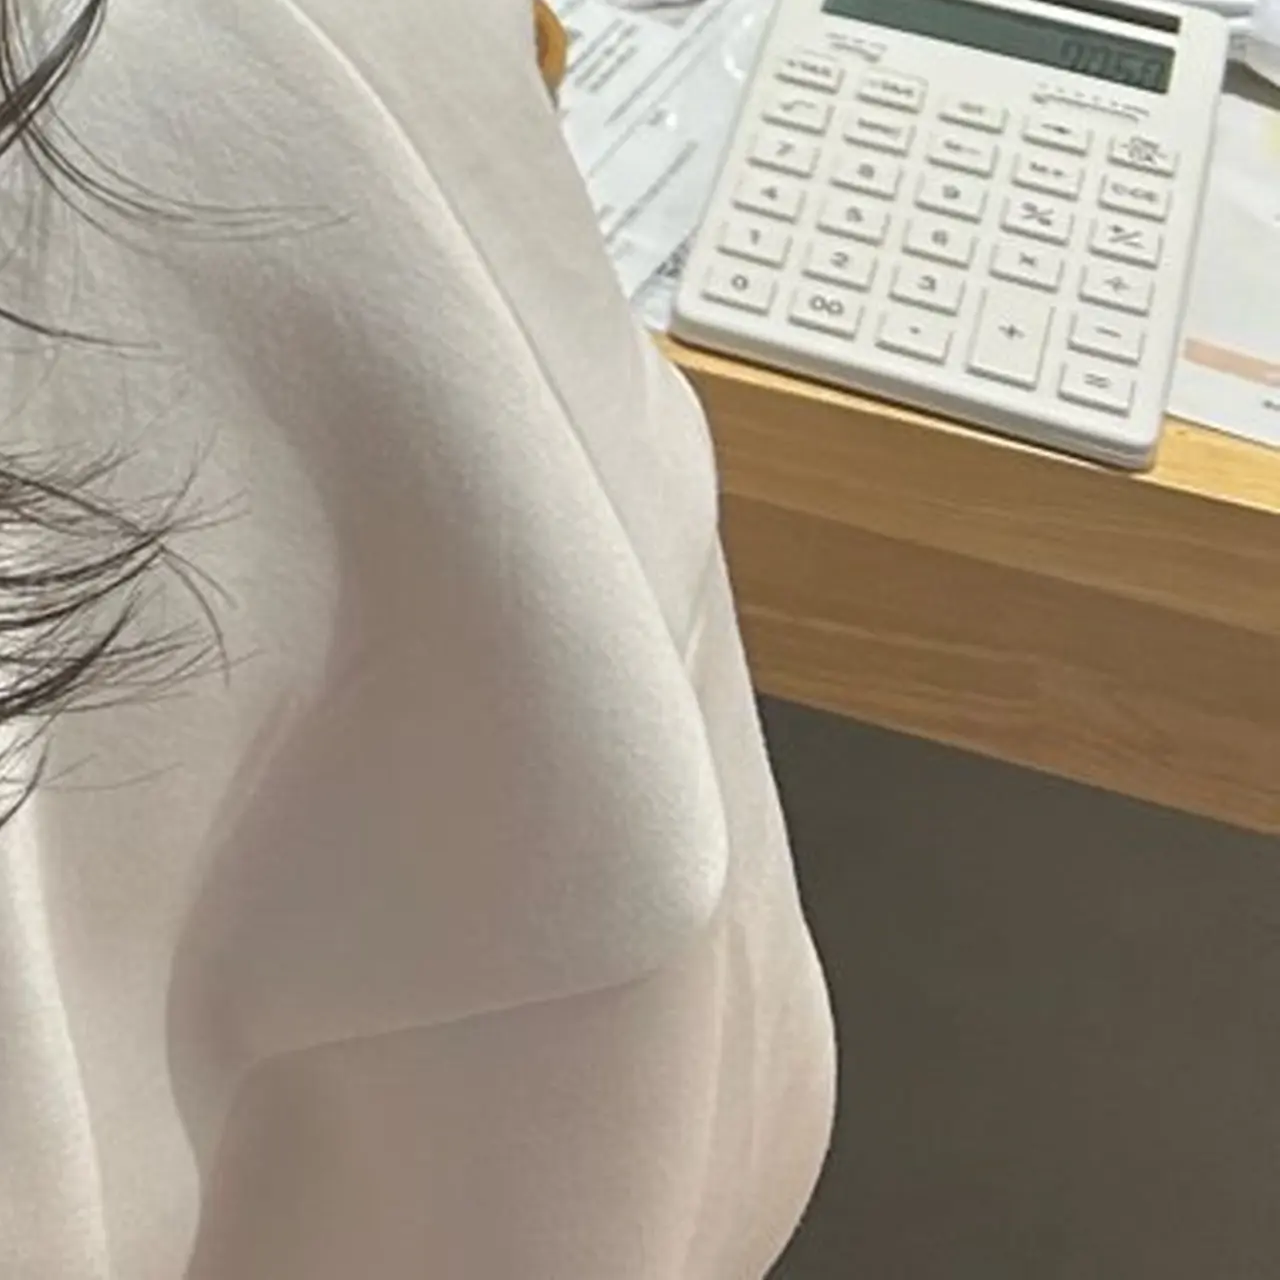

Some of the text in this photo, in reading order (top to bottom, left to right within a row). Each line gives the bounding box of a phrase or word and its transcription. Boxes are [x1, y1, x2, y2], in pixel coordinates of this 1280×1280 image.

[829, 251, 850, 269] 2
[730, 273, 749, 291] 0
[917, 274, 938, 292] 3
[808, 294, 845, 317] 00
